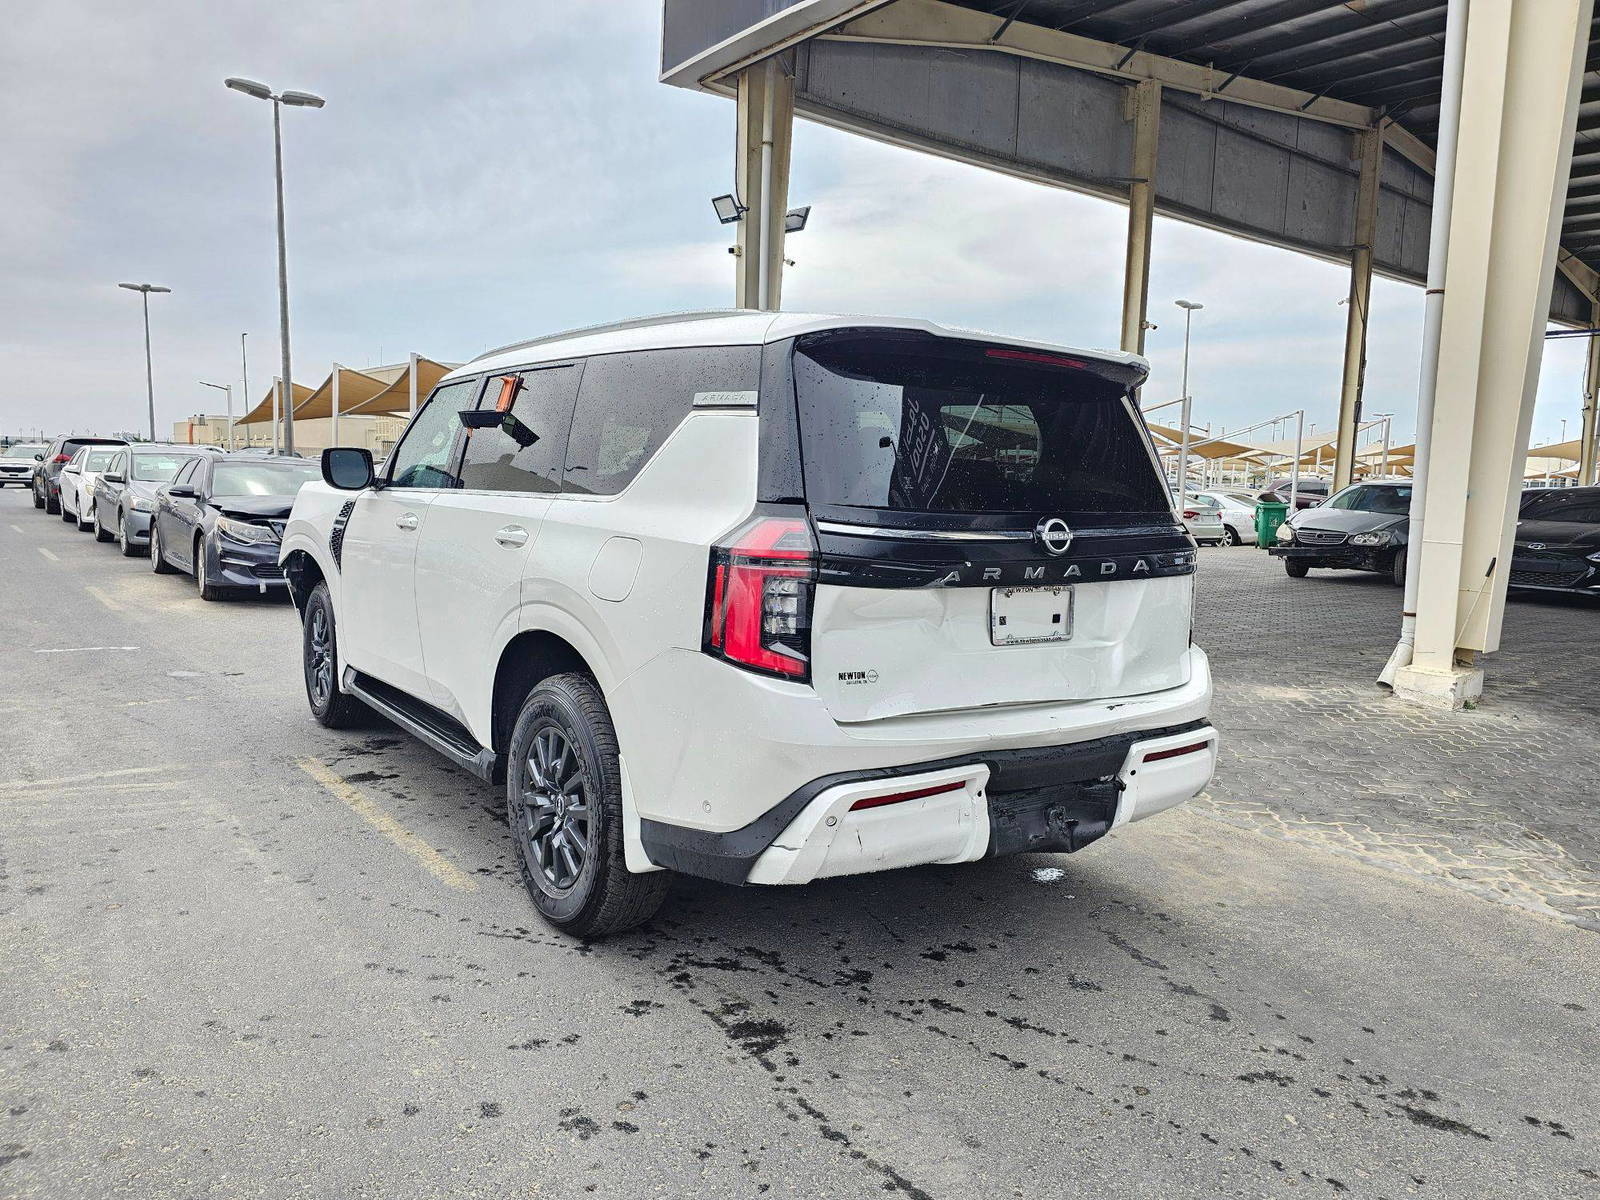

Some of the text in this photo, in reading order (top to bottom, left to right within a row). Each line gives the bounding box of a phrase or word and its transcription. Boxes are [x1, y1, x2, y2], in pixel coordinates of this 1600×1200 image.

[1042, 531, 1073, 540] NISSAN
[939, 559, 1151, 584] ARMADA
[838, 671, 866, 681] NEWTON
